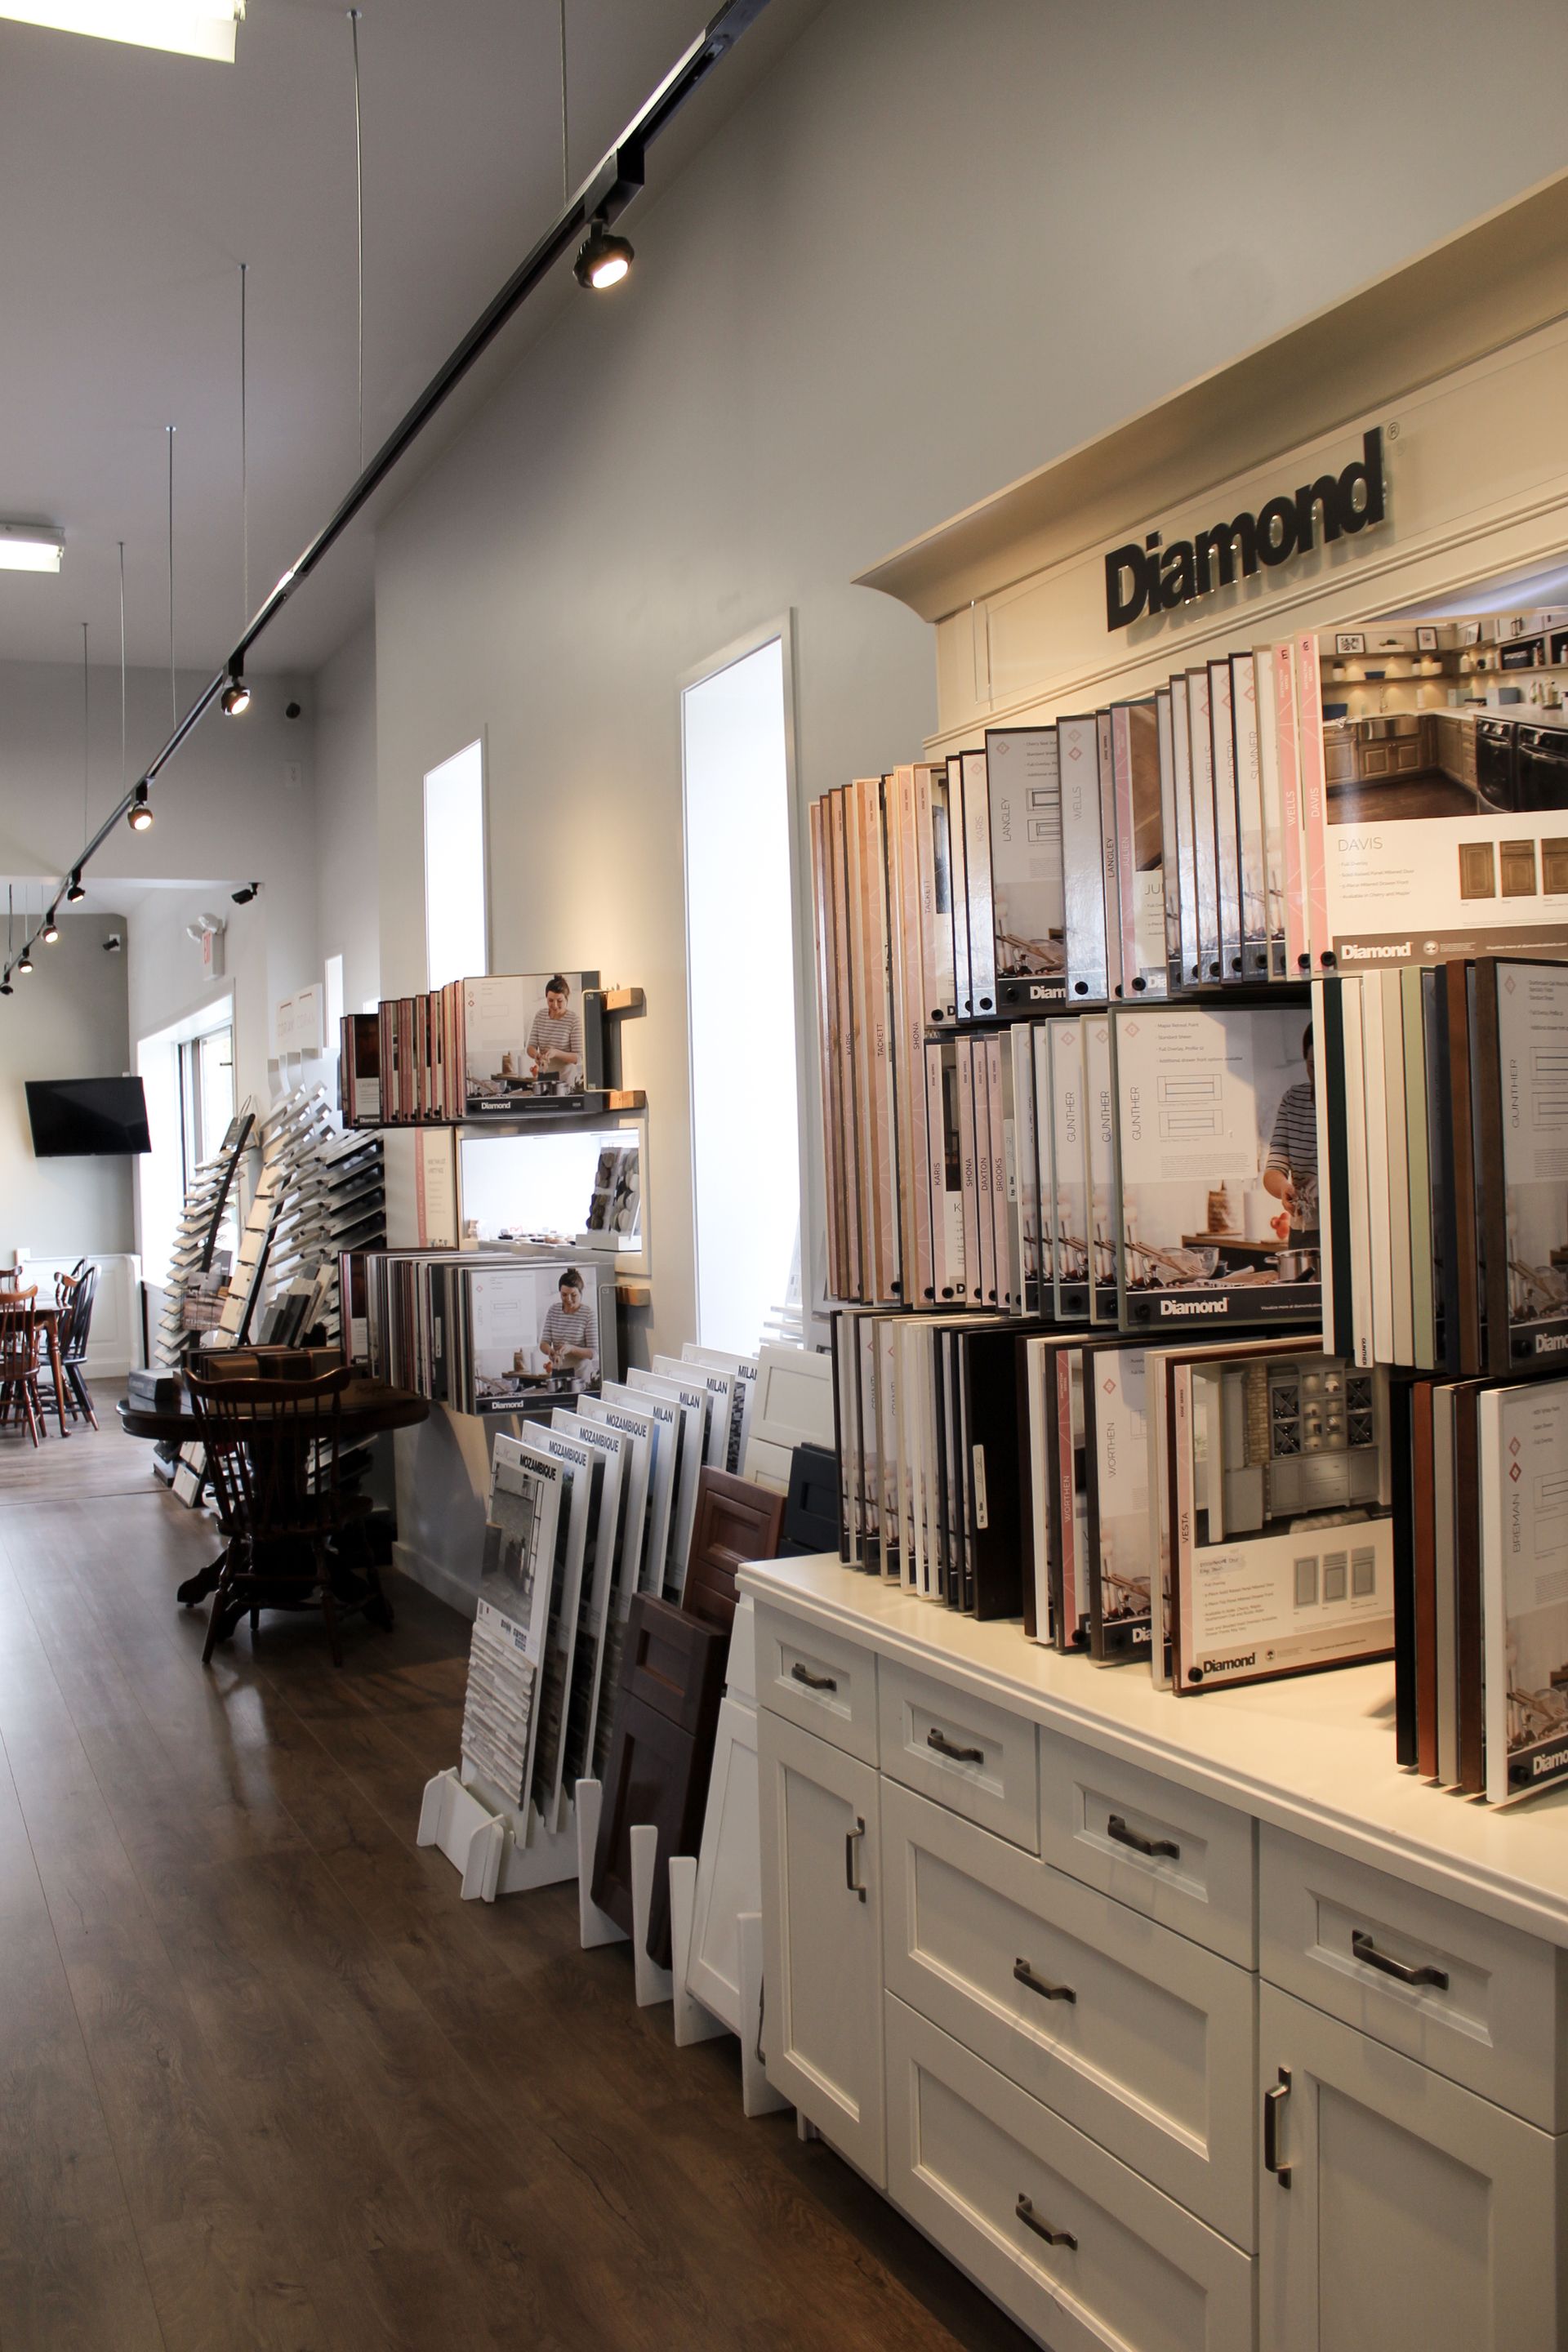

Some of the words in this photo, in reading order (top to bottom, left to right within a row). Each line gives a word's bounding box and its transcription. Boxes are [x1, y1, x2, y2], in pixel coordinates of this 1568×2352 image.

[1106, 426, 1385, 632] Diamond
[1249, 731, 1258, 780] SUMNER
[1071, 786, 1083, 821] WELLS
[1287, 790, 1295, 826] WELLS
[1310, 786, 1319, 818] DAVIS
[975, 815, 985, 843] KARIS
[1000, 797, 1012, 842] LANGLEY
[1106, 837, 1116, 879] LANGLEY
[1120, 835, 1130, 868] JULIEN
[1338, 836, 1383, 852] DAVIS
[1340, 942, 1412, 960] Diamond
[481, 1102, 511, 1110] Diamond
[1510, 1059, 1520, 1129] GUNTHER
[1065, 1092, 1076, 1143] GUNTHER
[1100, 1091, 1111, 1143] GUNTHER
[1130, 1086, 1143, 1141] GUNTHER
[1160, 1298, 1228, 1316] Diamond
[679, 1392, 700, 1410] MILAN
[706, 1378, 728, 1395] MILAN
[492, 1401, 524, 1410] Diamond
[653, 1405, 674, 1423] MILAN
[579, 1427, 619, 1453] MOZAMBIQUE
[606, 1413, 647, 1438] MOZAMBIQUE
[549, 1440, 587, 1467] MOZAMBIQUE
[1107, 1422, 1116, 1478] WORTHEN
[519, 1454, 557, 1481] MOZAMBIQUE
[1512, 1493, 1521, 1553] BREMAN
[1203, 1652, 1256, 1674] Diamond
